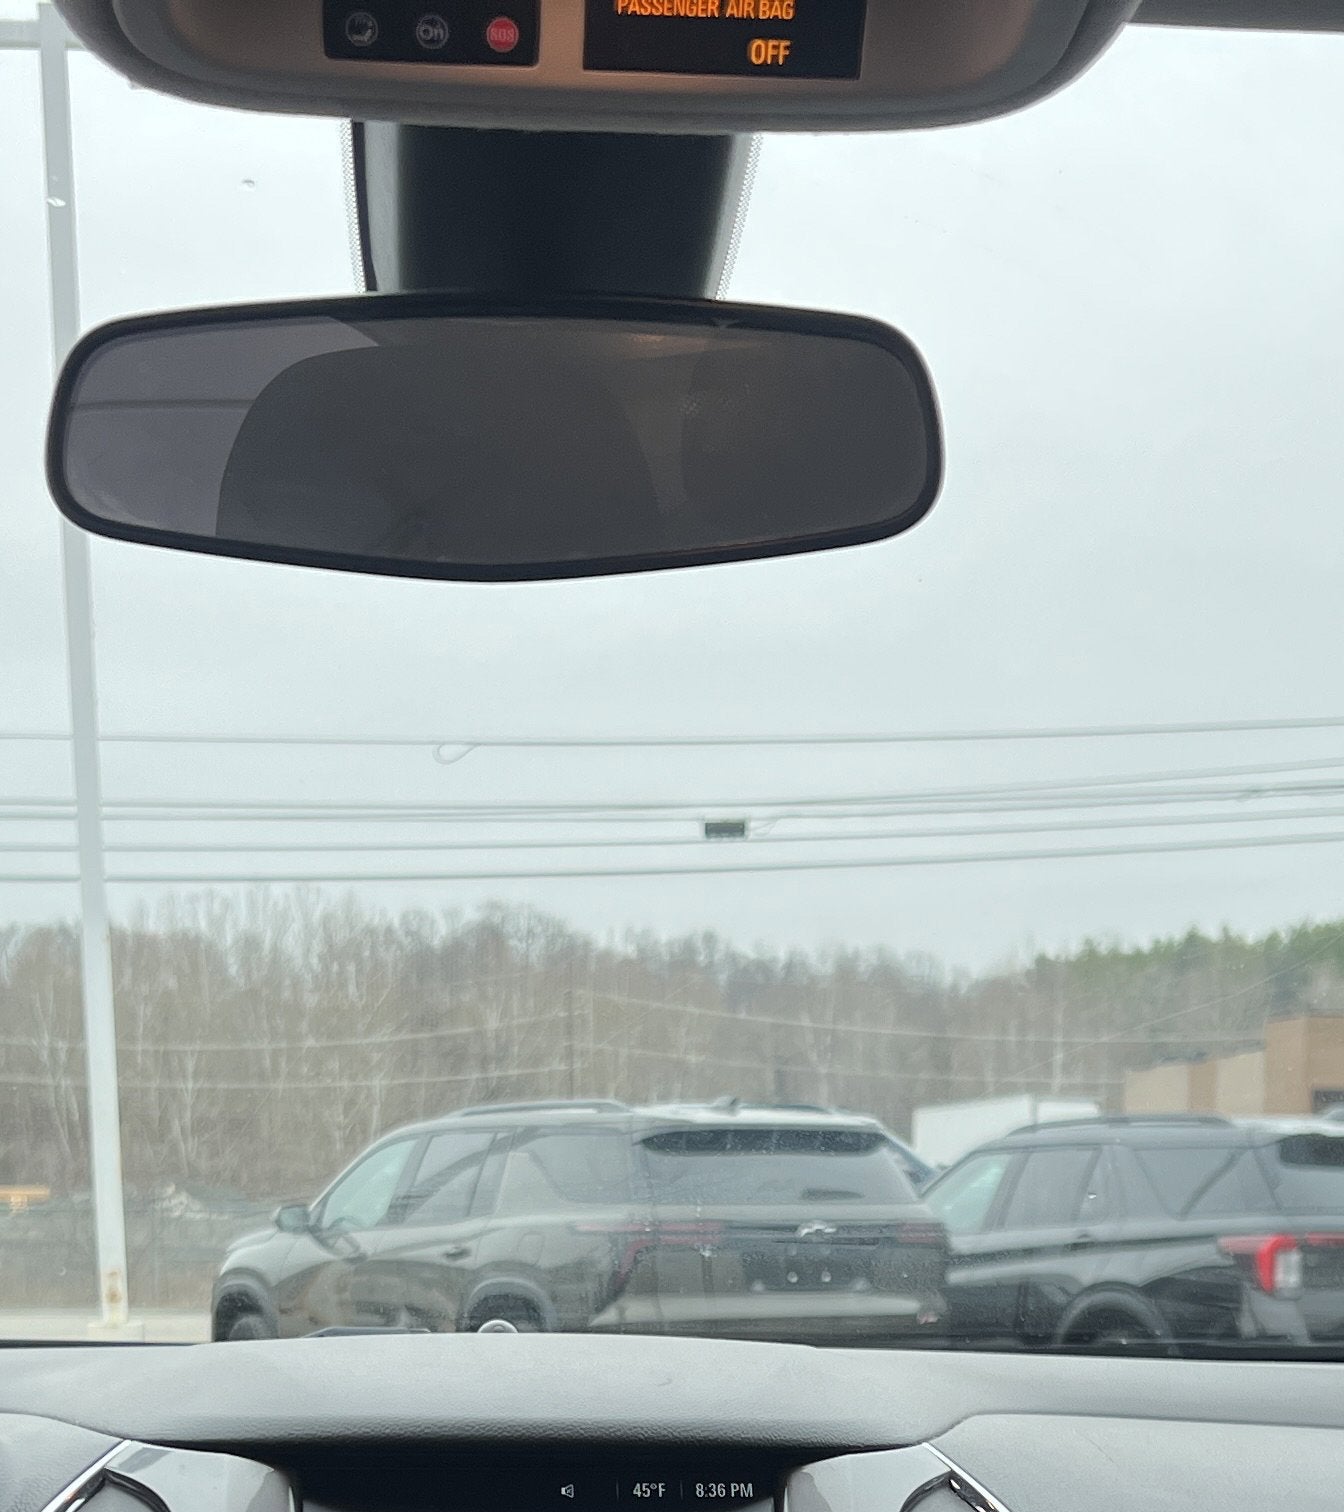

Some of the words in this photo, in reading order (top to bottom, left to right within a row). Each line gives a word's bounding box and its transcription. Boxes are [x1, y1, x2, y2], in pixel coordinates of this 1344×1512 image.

[616, 0, 719, 18] PASSENGER
[725, 0, 755, 19] AIR
[758, 1, 795, 20] BAG
[490, 27, 515, 43] SOS
[749, 39, 791, 66] OFF
[632, 1482, 666, 1498] 45°F
[695, 1483, 726, 1498] 8:36
[730, 1483, 754, 1498] PM
